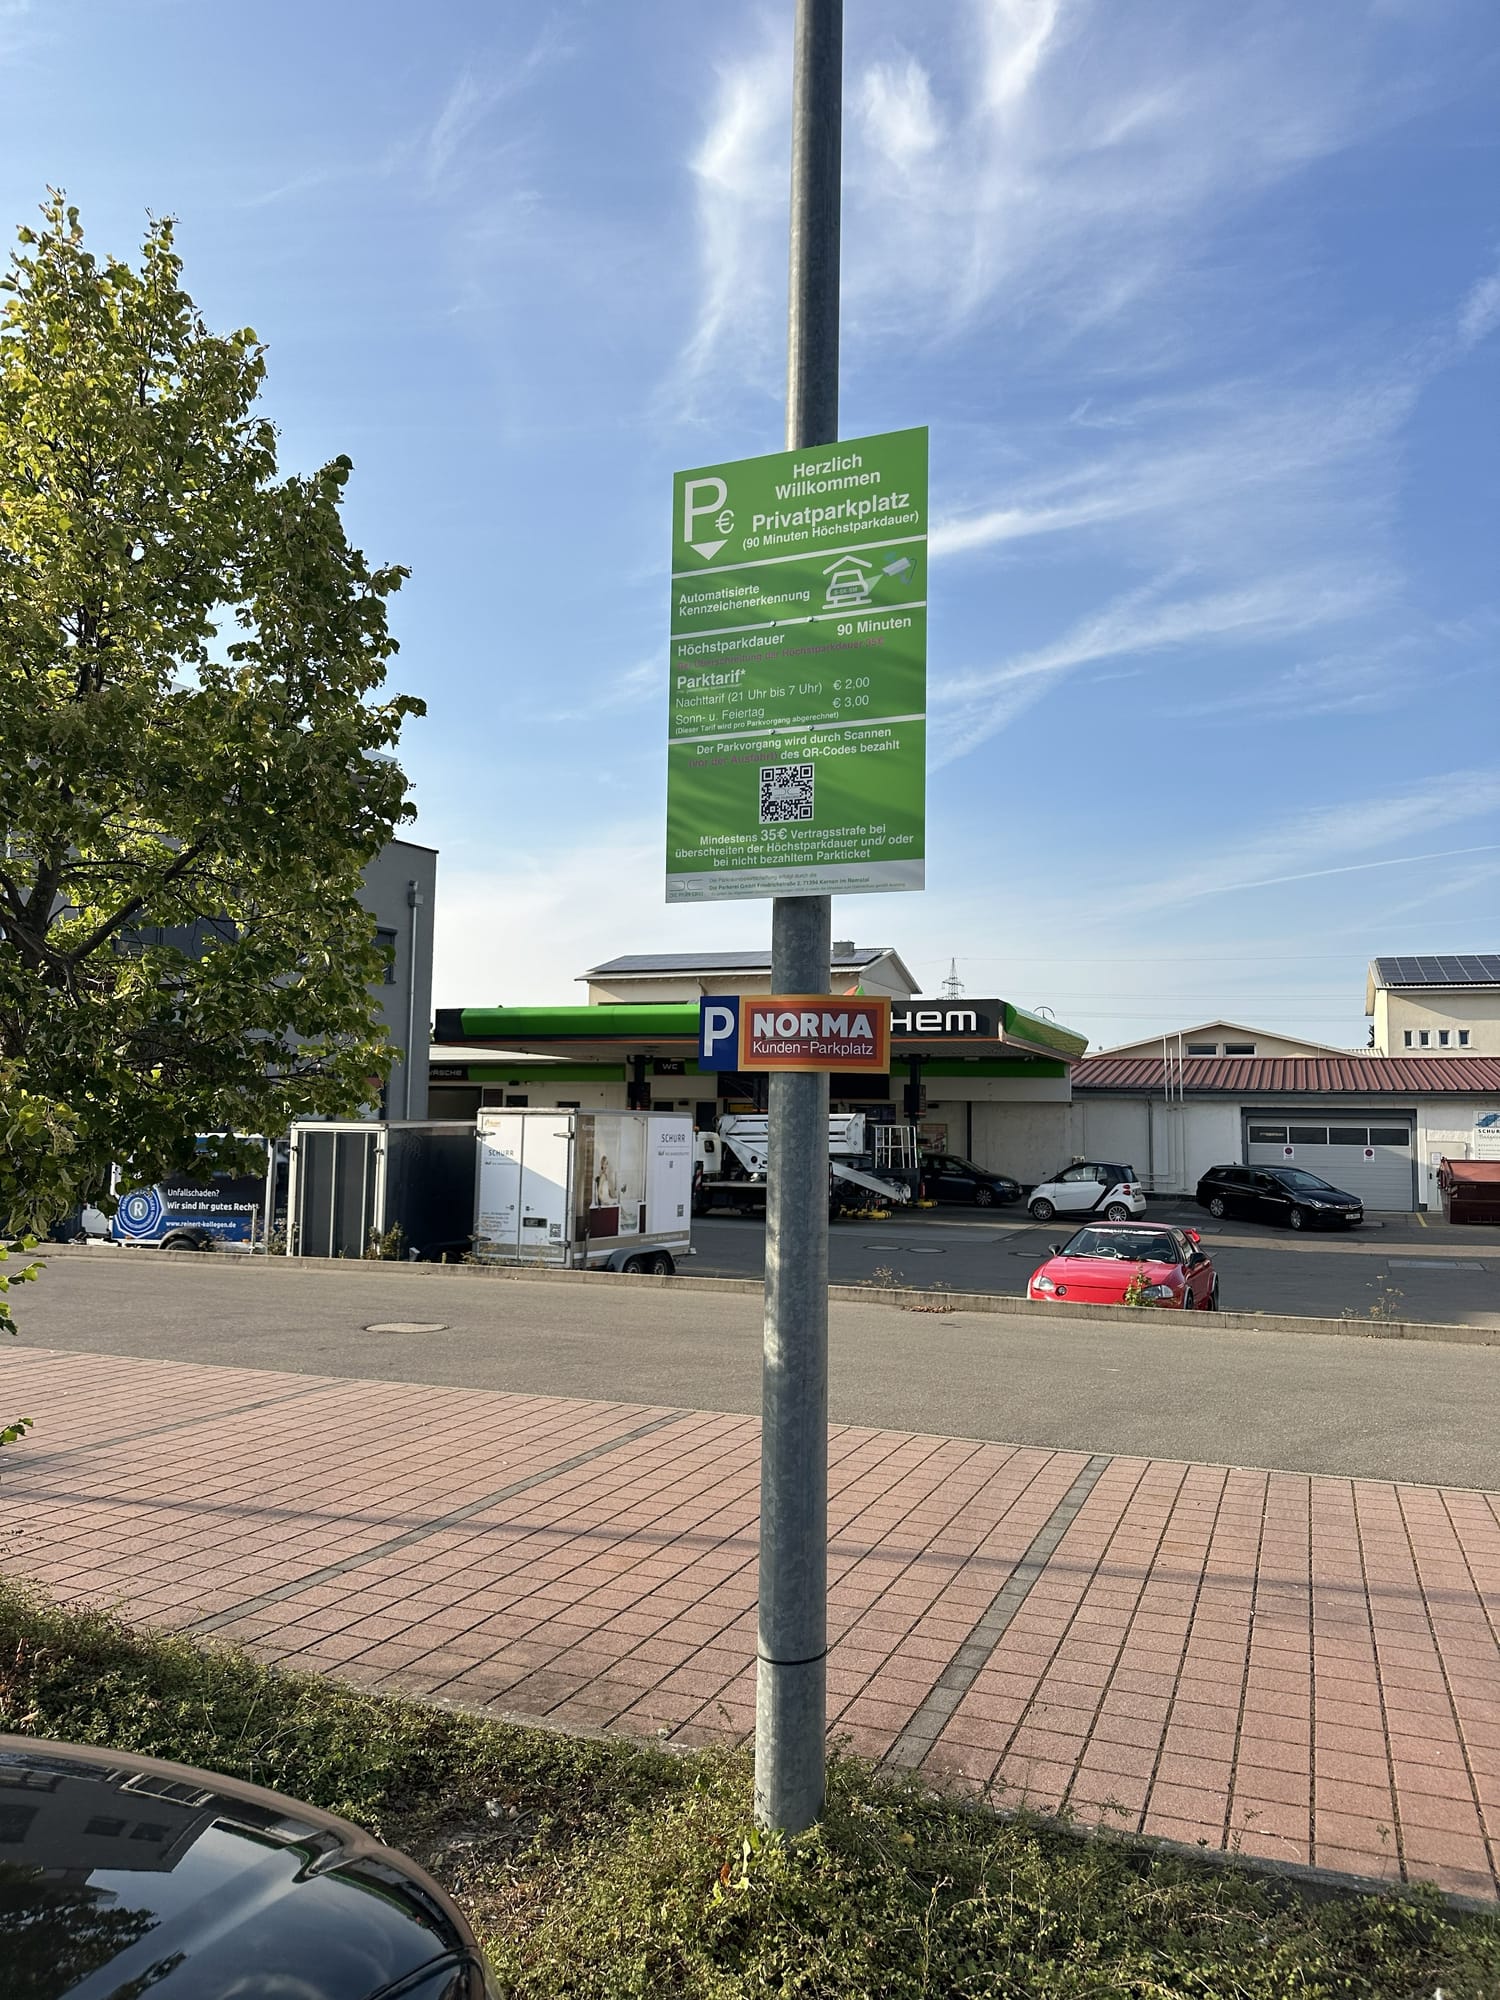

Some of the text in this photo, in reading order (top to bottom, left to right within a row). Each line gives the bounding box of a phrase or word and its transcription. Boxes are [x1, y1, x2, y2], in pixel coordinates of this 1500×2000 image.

[793, 453, 862, 479] Herzlich
[775, 471, 881, 500] Willkommen
[684, 477, 735, 543] P €
[752, 492, 910, 533] Privatparkplatz
[742, 510, 919, 551] (90 Minuten Höchstparkdauer)
[679, 584, 760, 605] Automatisierte
[679, 590, 810, 616] Kennzeichenerkennung
[678, 617, 912, 657] Höchstparkdauer 90 Minuten
[676, 693, 725, 709] Nachttarif
[728, 691, 744, 704] (21
[748, 688, 767, 700] Uhr
[770, 687, 786, 698] bis
[788, 685, 796, 696] 7
[799, 682, 823, 695] Uhr)
[833, 679, 842, 691] €
[675, 713, 706, 725] Sonn-
[708, 713, 718, 721] u.
[722, 707, 765, 720] Feiertag
[832, 697, 841, 708] €
[675, 711, 839, 735] (Dieser Tarif wird pro Parkvorgang abgerechnet)
[696, 728, 891, 755] Der Parkvorgang wird durch Scannen
[780, 750, 800, 760] des
[802, 745, 857, 758] QR-Codes
[860, 740, 900, 753] bezahlt
[675, 845, 744, 858] überschreiten
[747, 844, 764, 854] der
[767, 838, 858, 852] Höchstparkdauer
[888, 835, 914, 845] oder
[700, 823, 886, 846] Mindestens 35€ Vertragsstrafe bei
[713, 849, 871, 867] bei nicht bezahltem Parkticket
[703, 1006, 735, 1057] P
[753, 1012, 873, 1039] NORMA
[753, 1041, 873, 1056] Kunden-Parkplatz
[167, 1188, 220, 1197] Unfallschaden?
[133, 1201, 143, 1217] R
[167, 1201, 180, 1210] Wir
[181, 1201, 197, 1210] sind
[198, 1202, 209, 1210] Ihr
[210, 1203, 233, 1212] gutes
